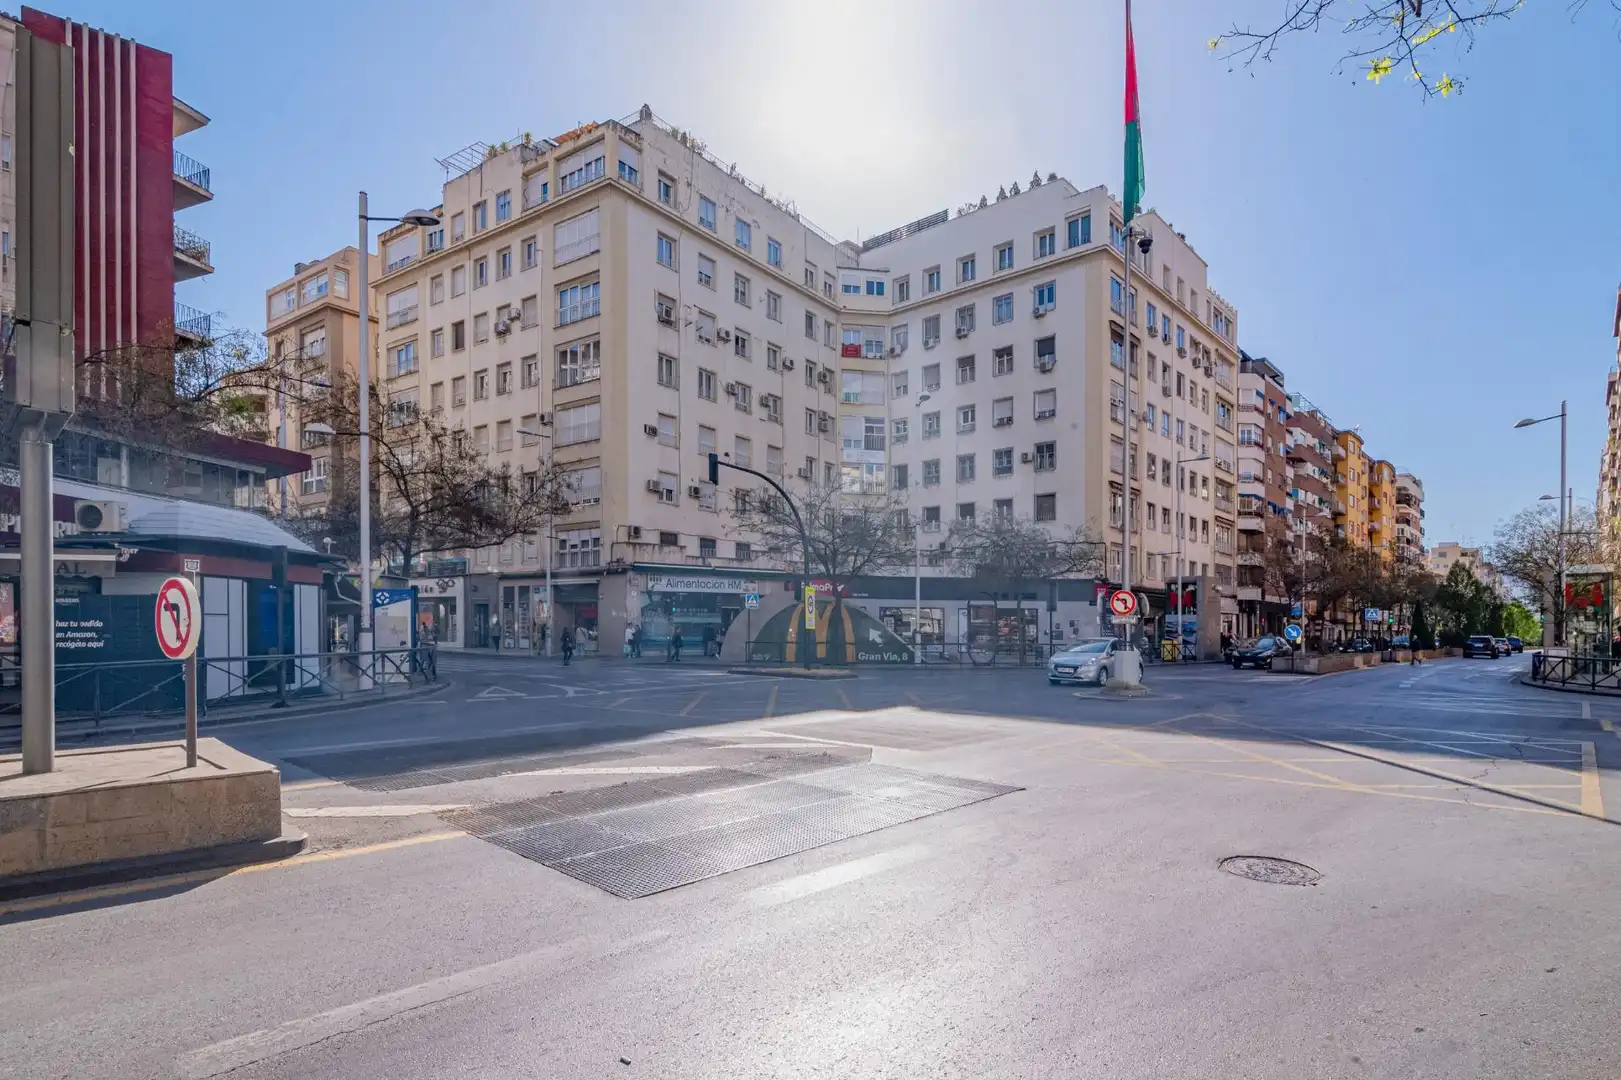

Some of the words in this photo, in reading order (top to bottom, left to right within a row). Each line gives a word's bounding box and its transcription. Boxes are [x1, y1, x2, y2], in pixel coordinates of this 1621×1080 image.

[666, 578, 725, 589] Alimentación
[728, 581, 742, 590] HM
[858, 651, 881, 661] Gran
[902, 652, 909, 661] 8
